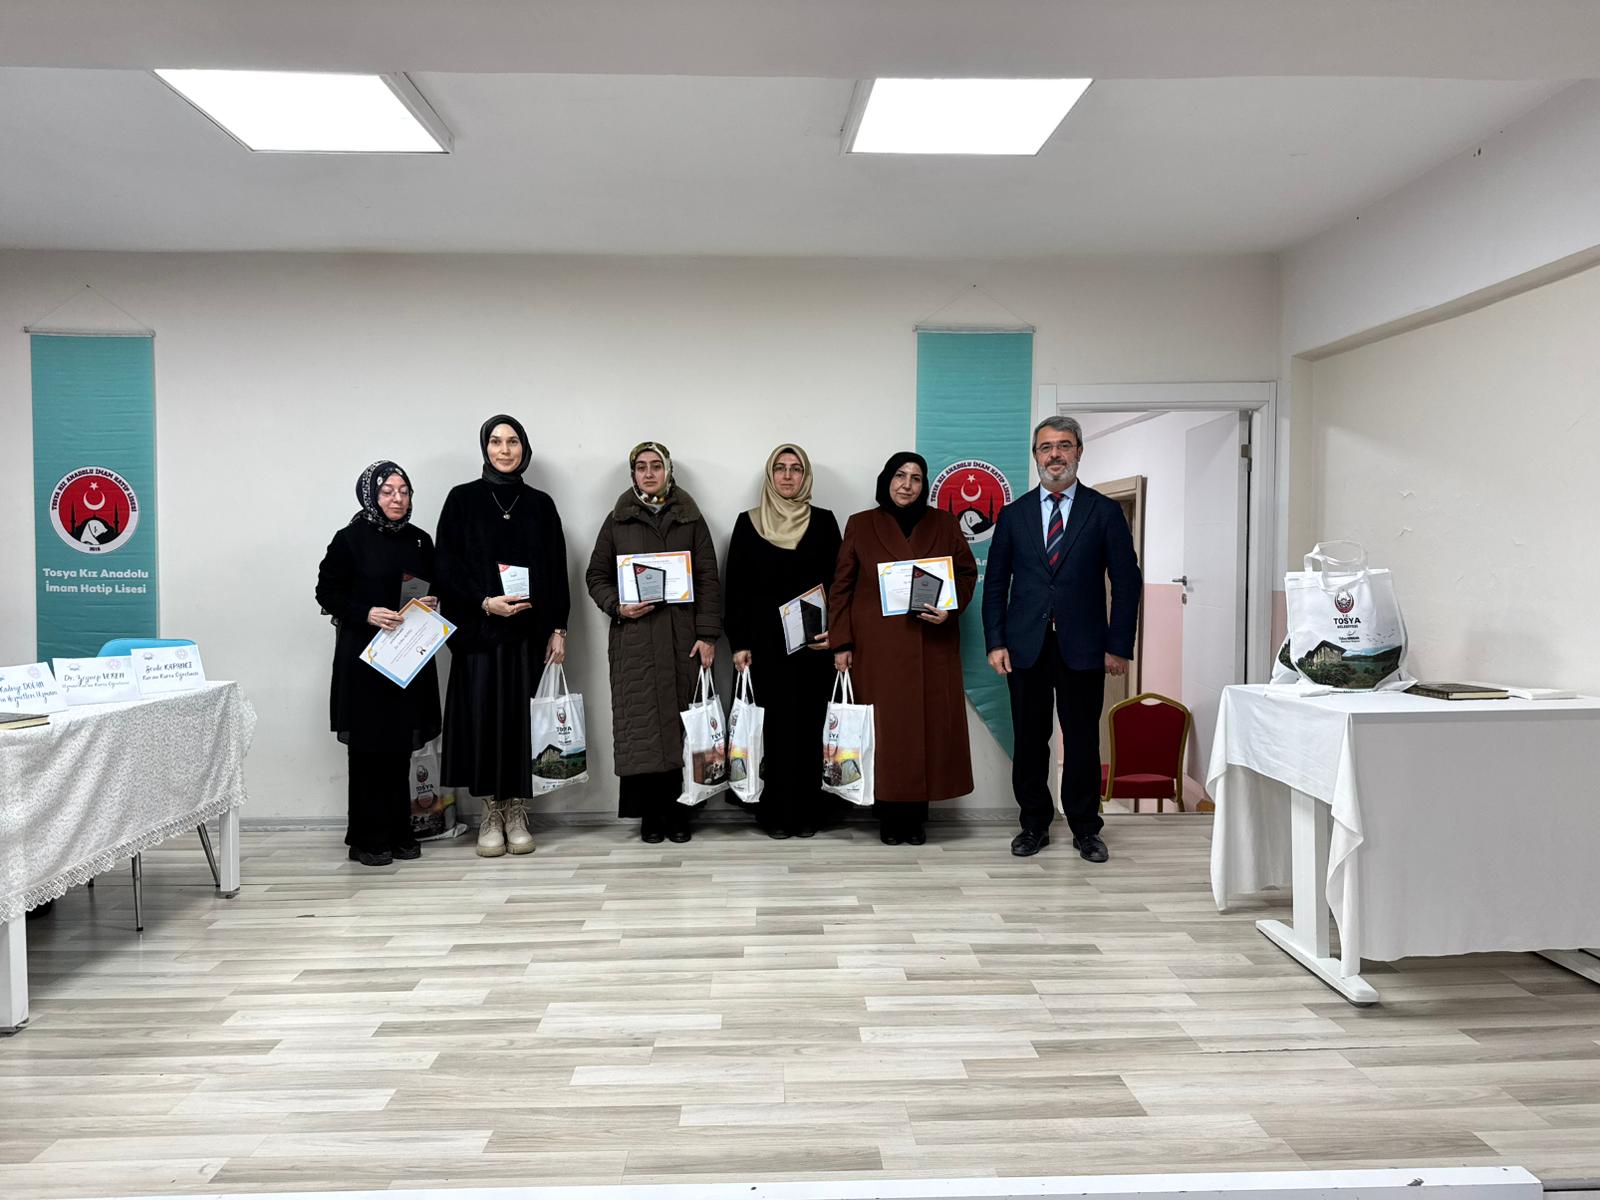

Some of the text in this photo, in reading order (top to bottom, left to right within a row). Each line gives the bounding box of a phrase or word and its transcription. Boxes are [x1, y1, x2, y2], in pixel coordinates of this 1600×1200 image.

[43, 568, 149, 579] Tosya Kız Anadolu
[46, 580, 147, 595] İmam Hatip Lisesi
